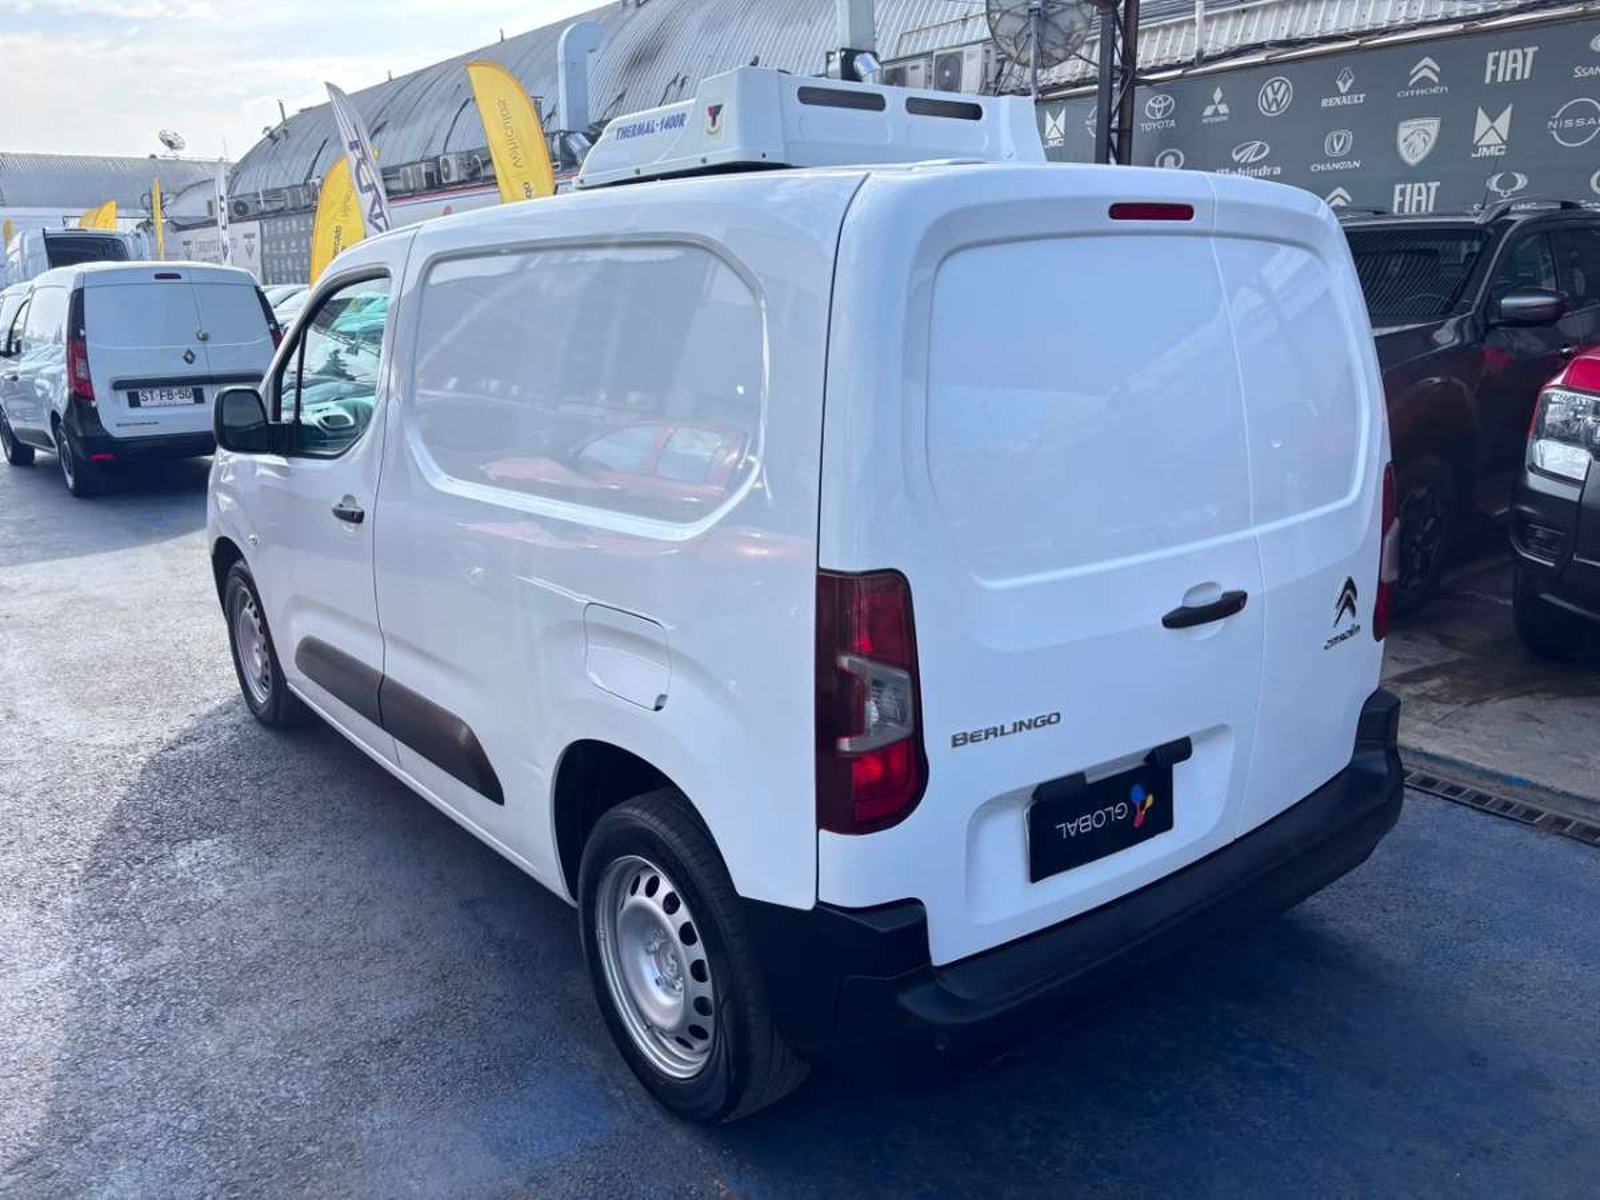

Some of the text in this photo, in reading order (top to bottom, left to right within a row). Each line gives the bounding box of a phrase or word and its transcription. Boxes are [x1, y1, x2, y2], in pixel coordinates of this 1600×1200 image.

[1485, 46, 1539, 84] FIAT
[1321, 93, 1366, 108] RENAULT
[1140, 119, 1176, 133] TOYOTA
[1547, 117, 1600, 129] NISSA
[1472, 144, 1507, 158] JMC
[1393, 181, 1440, 215] FIAT
[951, 712, 1061, 748] BERLINGO
[1056, 802, 1128, 839] GLOBAL
